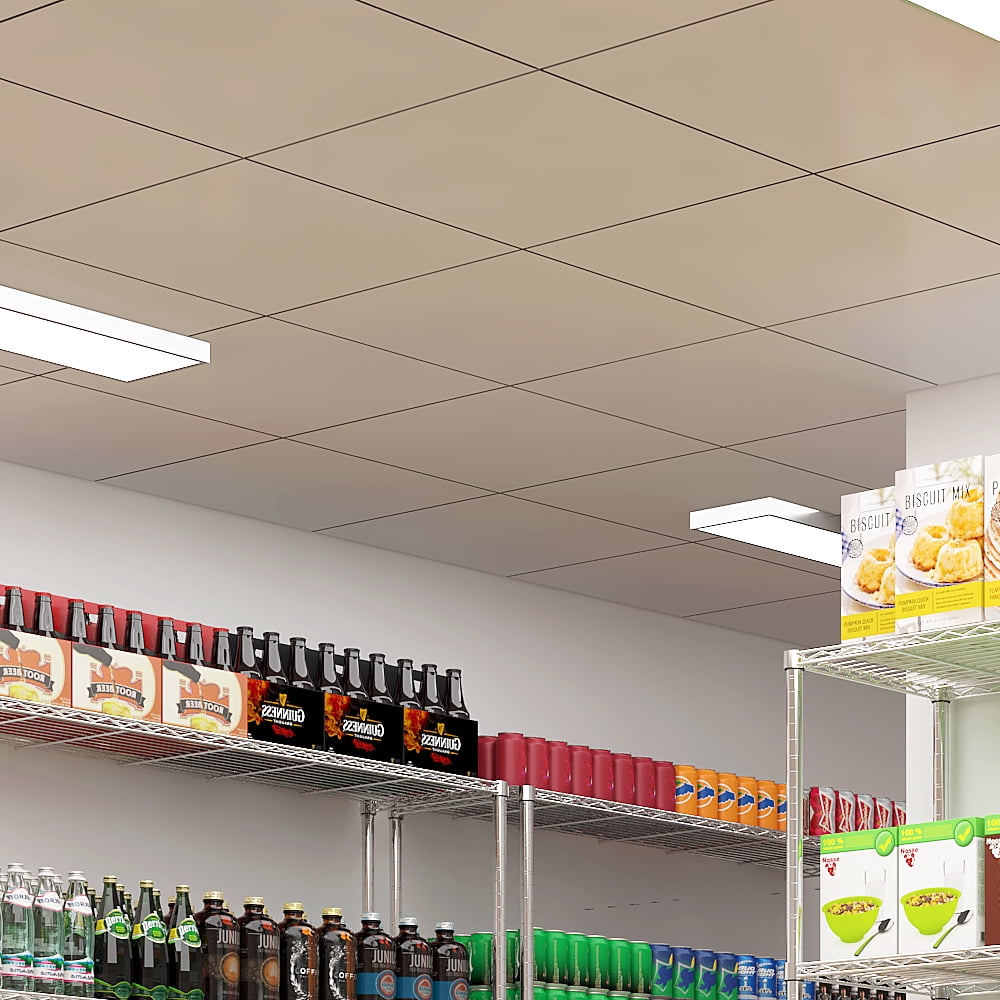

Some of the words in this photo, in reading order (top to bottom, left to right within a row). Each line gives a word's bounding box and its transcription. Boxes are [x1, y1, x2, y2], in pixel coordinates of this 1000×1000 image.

[905, 488, 946, 509] BISCUIT
[952, 483, 971, 500] MIX
[850, 512, 890, 533] BISCUIT
